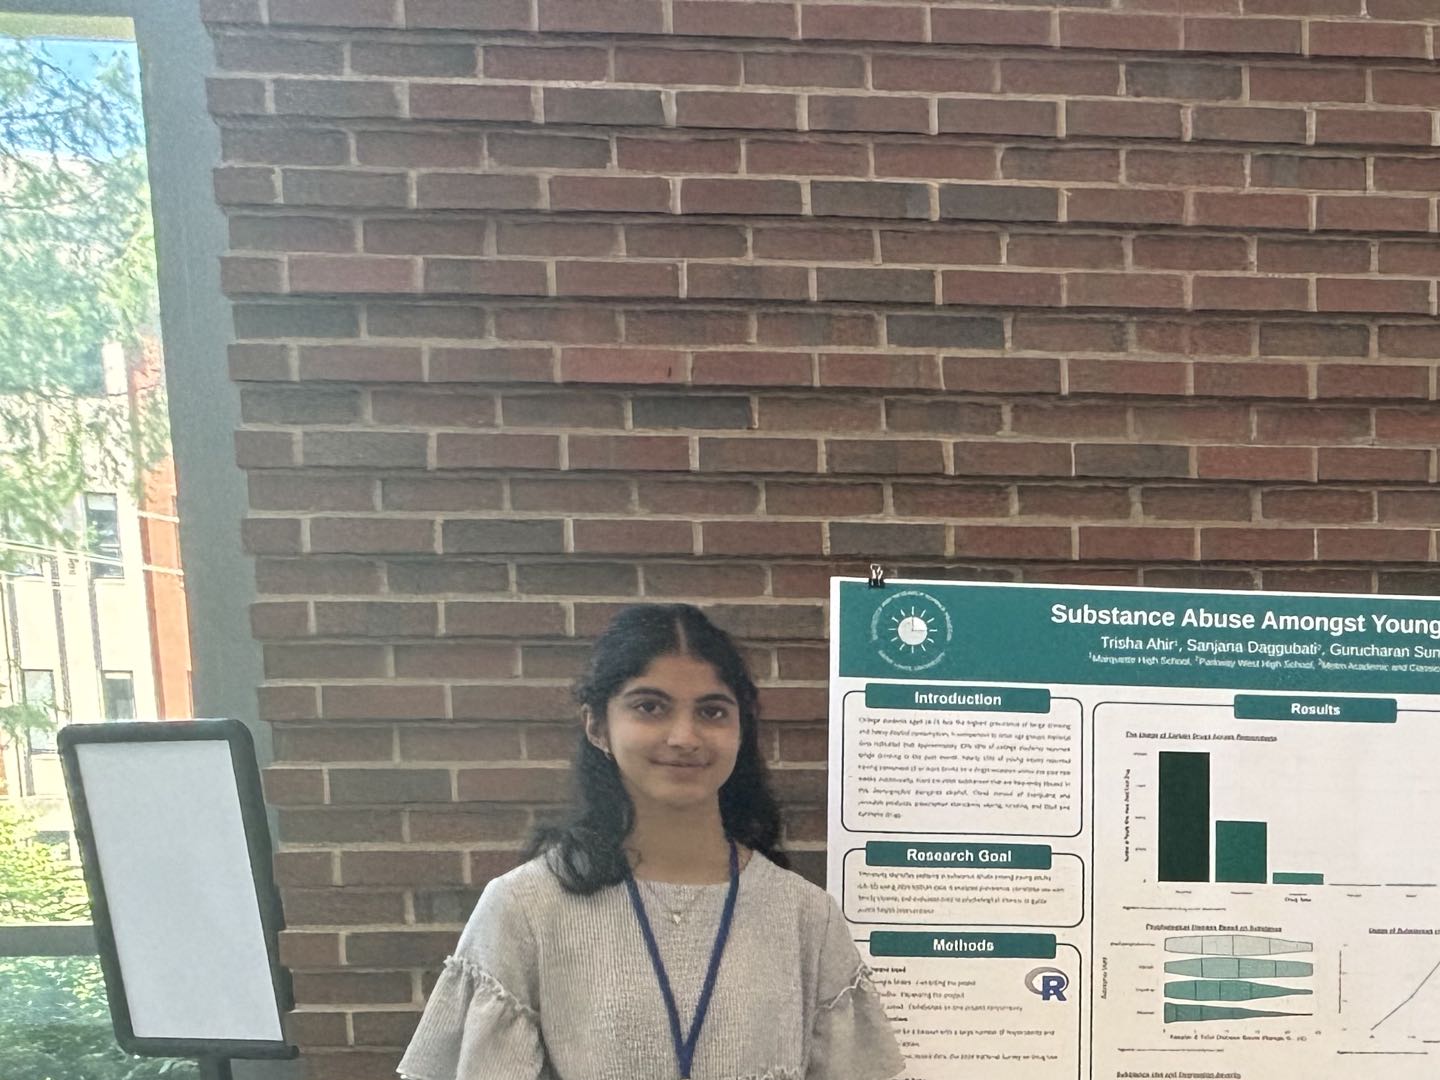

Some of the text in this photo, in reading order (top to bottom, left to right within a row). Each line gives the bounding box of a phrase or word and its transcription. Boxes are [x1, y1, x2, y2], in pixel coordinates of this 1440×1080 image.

[1051, 603, 1175, 626] Substance
[1181, 609, 1255, 629] Abuse
[1261, 611, 1366, 636] Amongst
[1101, 636, 1143, 650] Trisha
[1187, 639, 1243, 655] Sanjana
[1330, 643, 1410, 658] Gurucharan
[914, 691, 1002, 706] Introduction
[1291, 702, 1341, 716] Results
[907, 848, 1012, 863] Research Goal
[933, 938, 995, 952] Methods
[1041, 975, 1067, 1002] R
